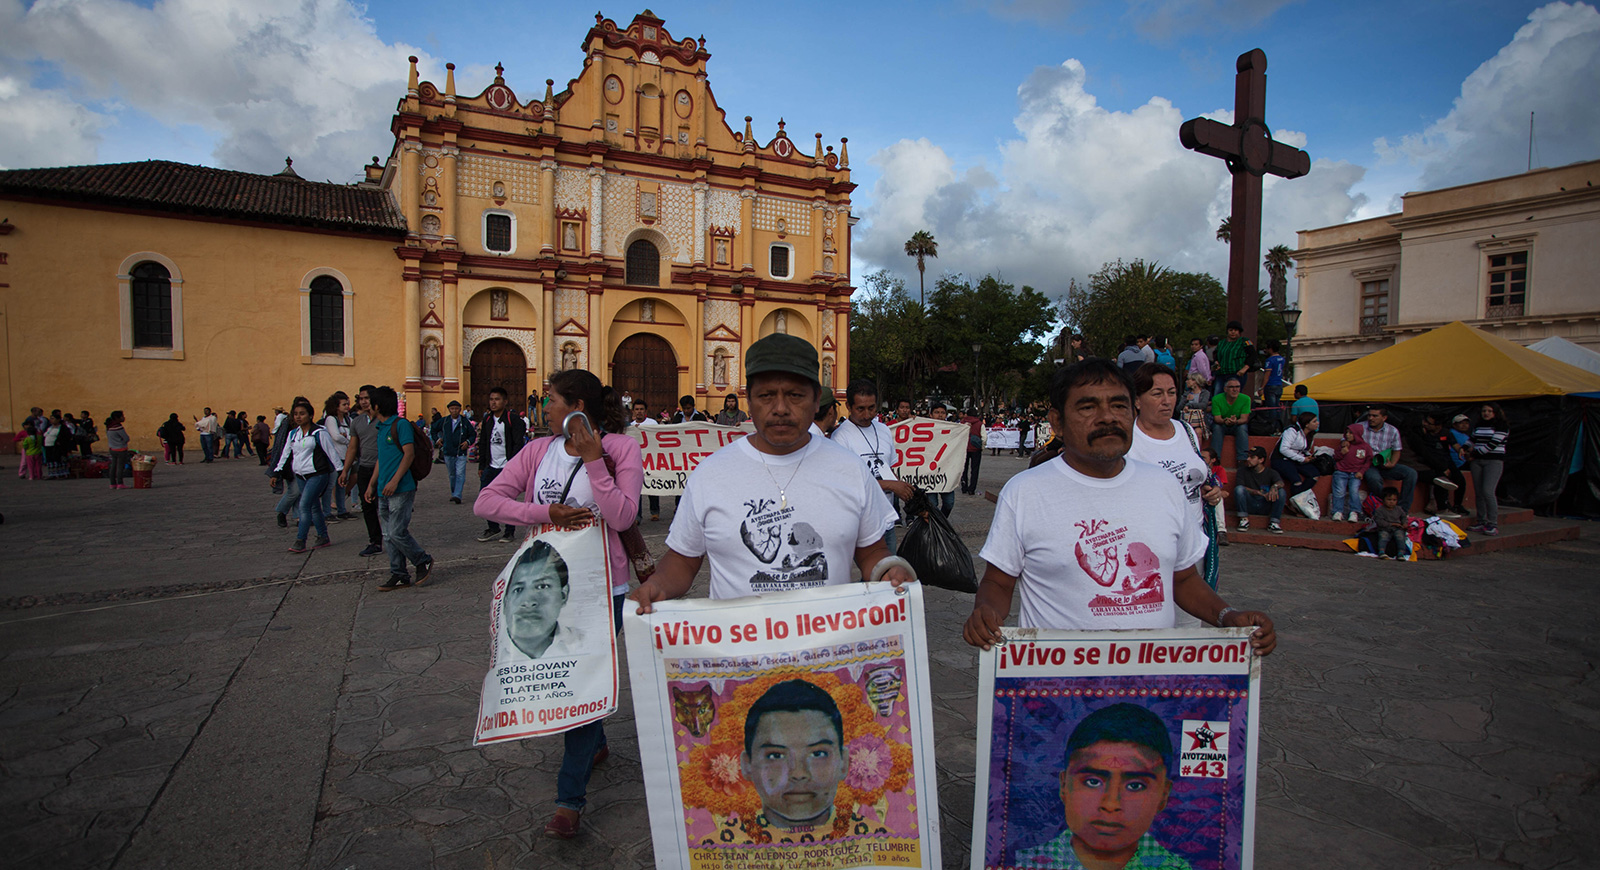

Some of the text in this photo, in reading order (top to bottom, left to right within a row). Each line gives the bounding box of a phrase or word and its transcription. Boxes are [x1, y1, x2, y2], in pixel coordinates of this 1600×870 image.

[654, 598, 906, 649] ¡Vivo se lo llevaron!
[1000, 641, 1248, 670] ¡Vivo se lo llevaron!
[496, 660, 578, 677] JESÚS JOVANY
[500, 670, 570, 685] RODRÍGUEZ
[504, 681, 566, 695] TLATEMPA
[500, 696, 526, 705] EDAD
[544, 690, 574, 700] AÑOS
[494, 710, 518, 728] VIDA
[522, 708, 534, 724] lo
[538, 696, 608, 725] queremos!
[1181, 752, 1227, 762] AYOTZINAPA
[1181, 761, 1225, 777] #43
[693, 852, 749, 861] CHRISTIAN
[754, 851, 798, 860] ALFONSO
[866, 843, 916, 853] TELUMBRE
[891, 854, 910, 862] años
